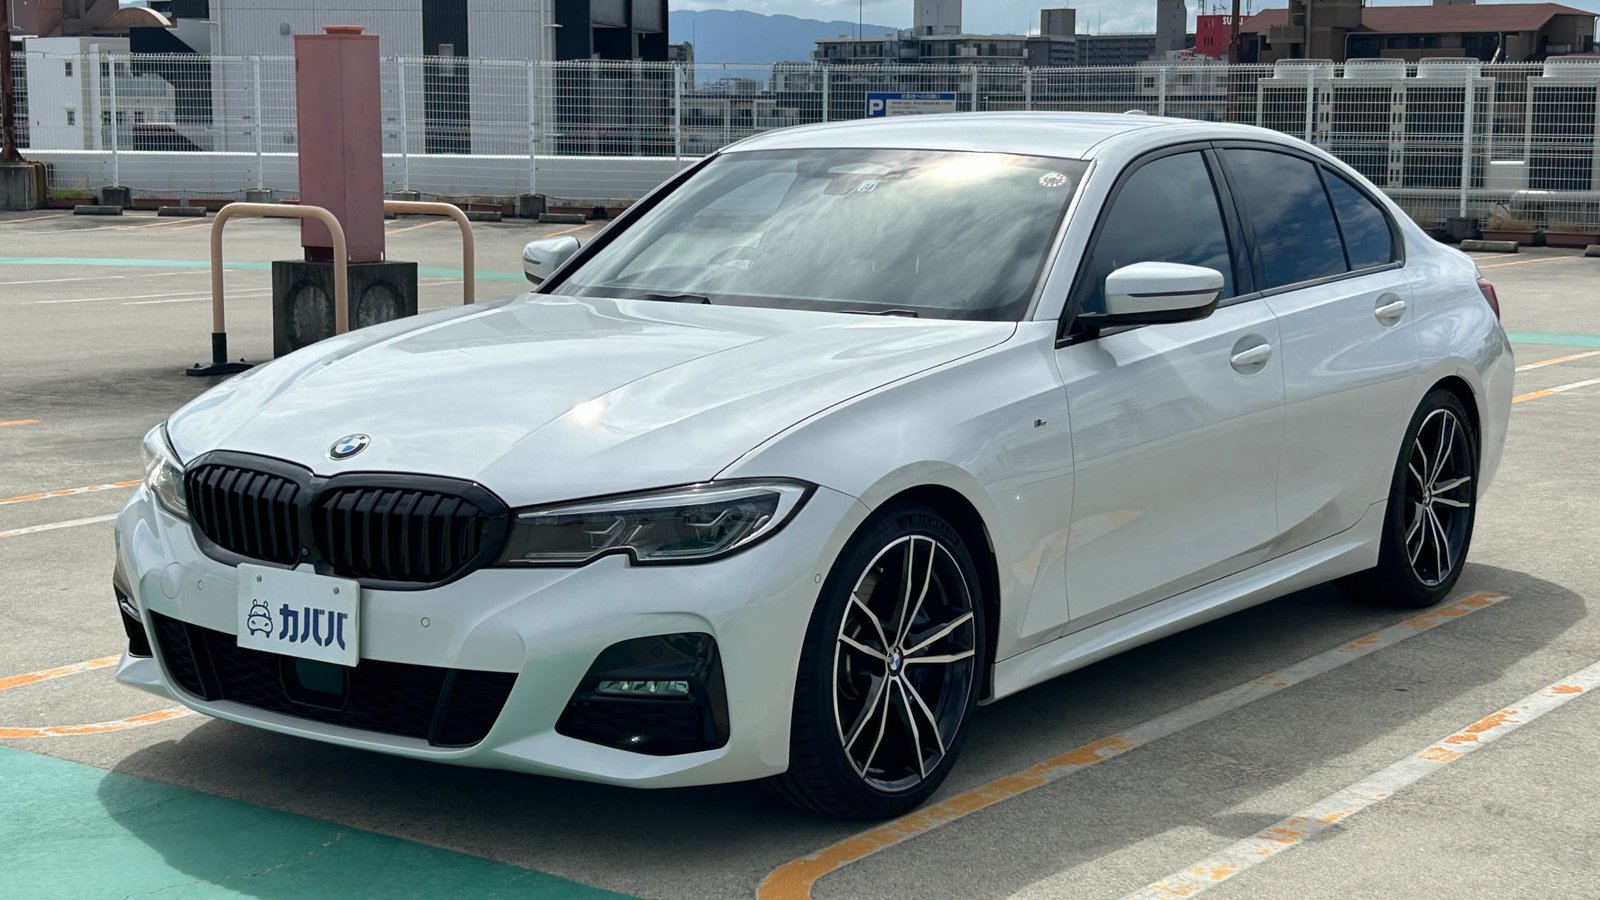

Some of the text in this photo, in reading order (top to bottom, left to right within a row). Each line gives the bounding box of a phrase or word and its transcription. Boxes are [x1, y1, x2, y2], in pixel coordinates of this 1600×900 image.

[869, 100, 884, 116] P
[279, 603, 348, 651] カババ
